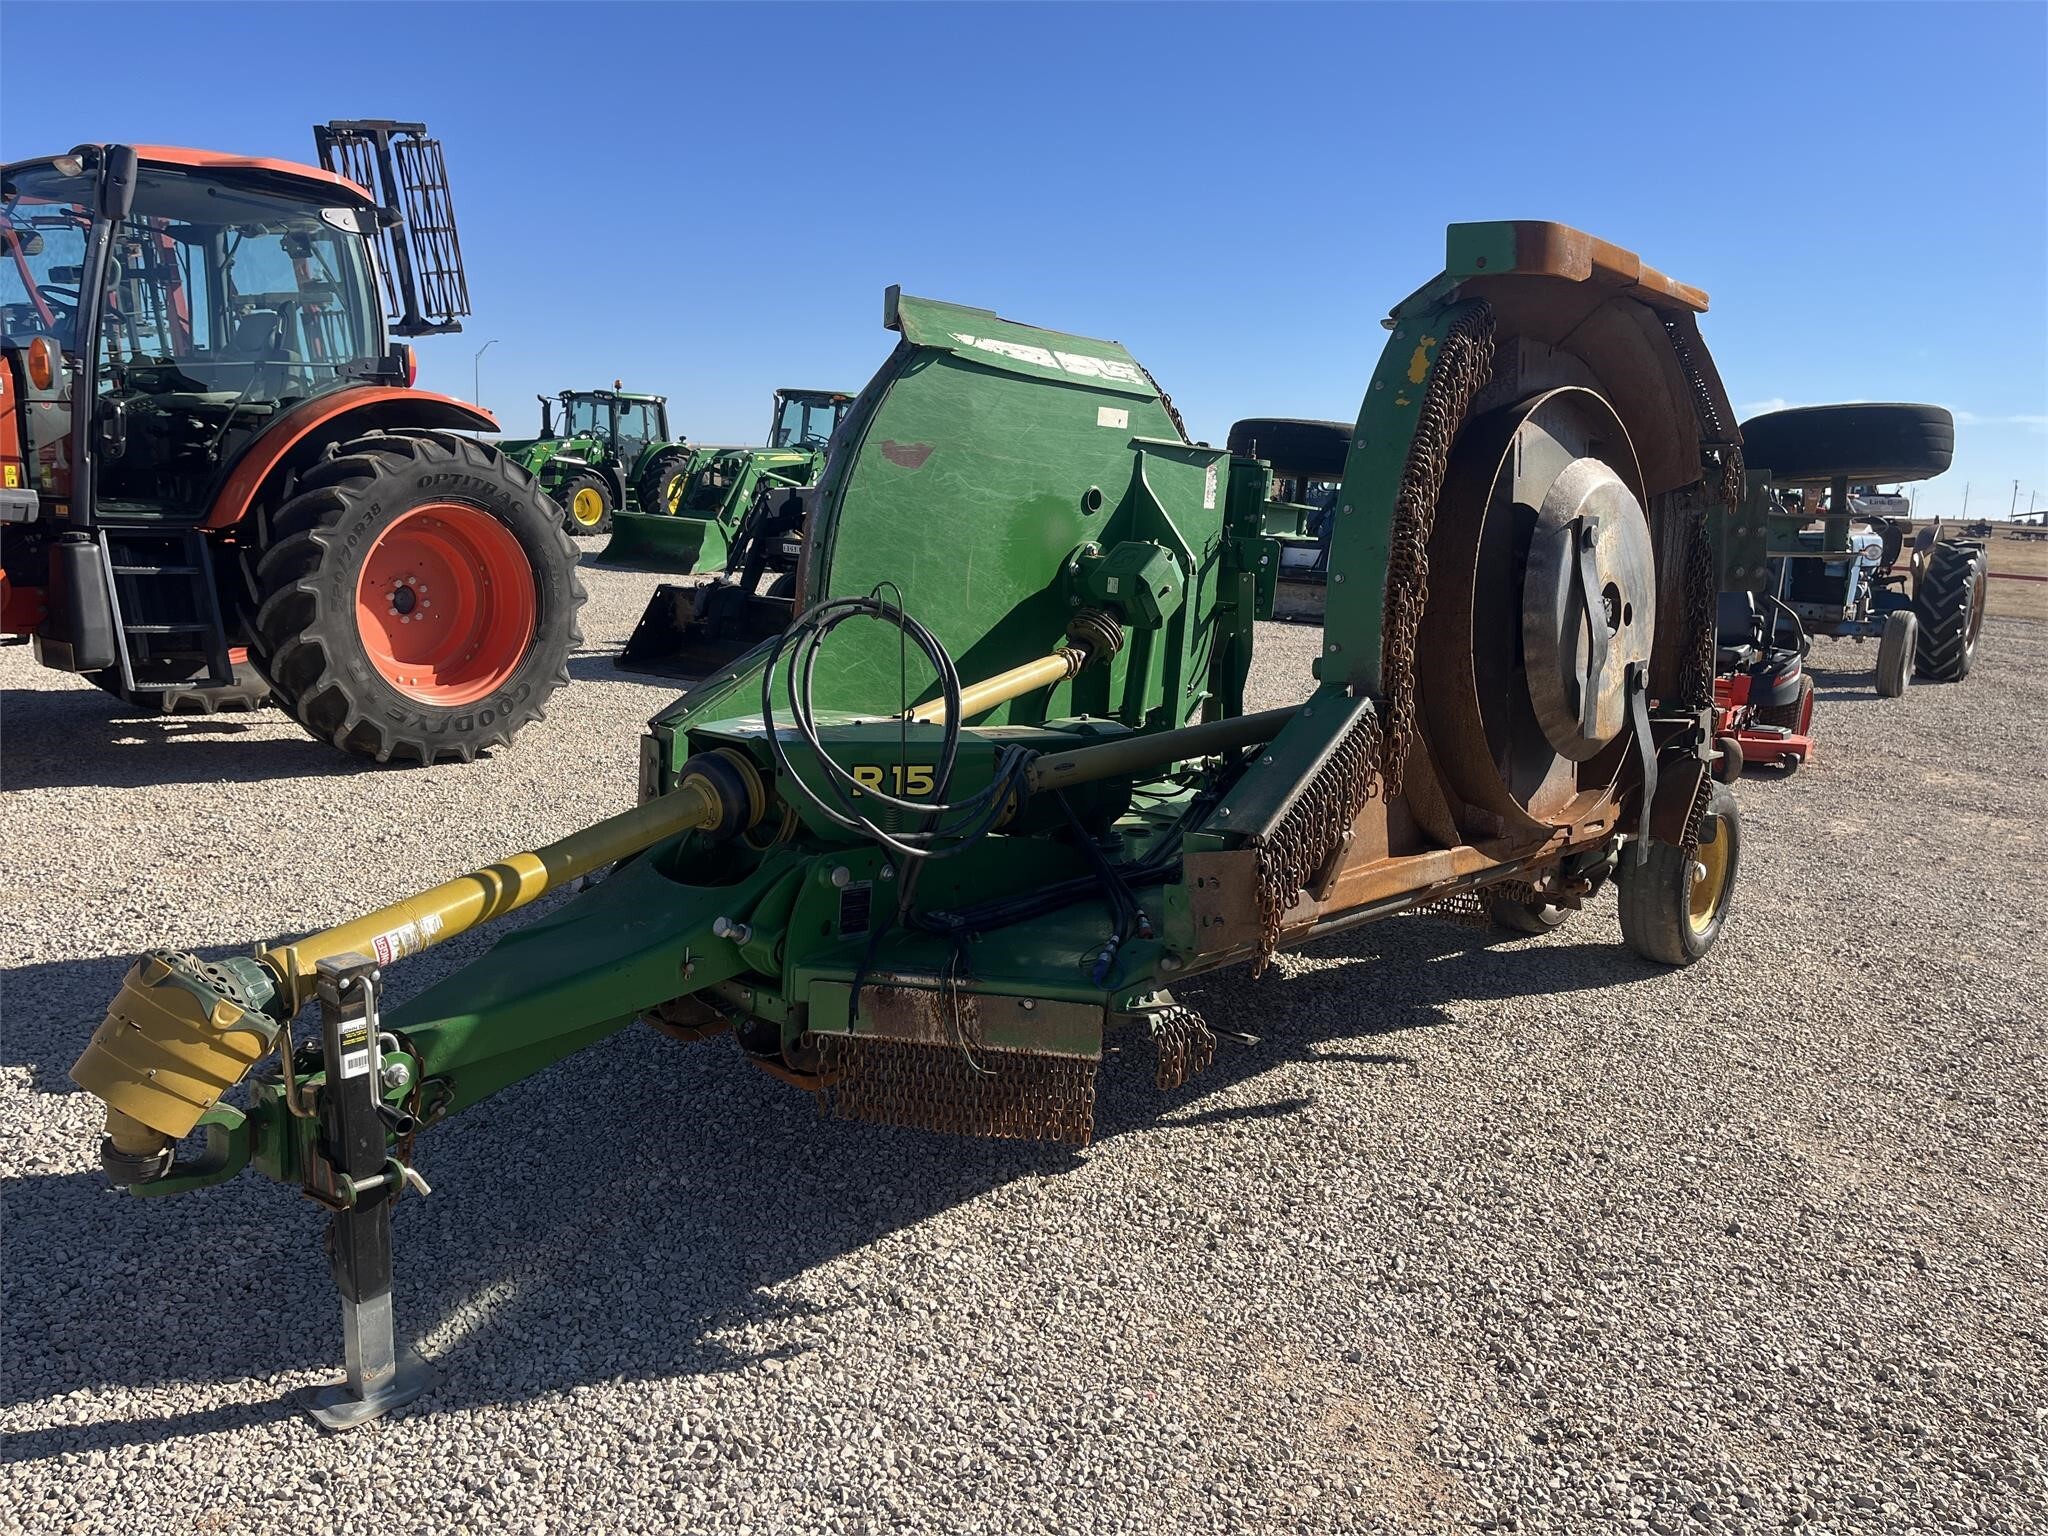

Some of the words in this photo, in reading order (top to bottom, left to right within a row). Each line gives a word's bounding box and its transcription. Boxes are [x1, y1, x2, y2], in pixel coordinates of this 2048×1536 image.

[416, 473, 525, 513] OPTITRAC
[348, 665, 531, 734] GOODYE
[377, 937, 390, 967] ANGER
